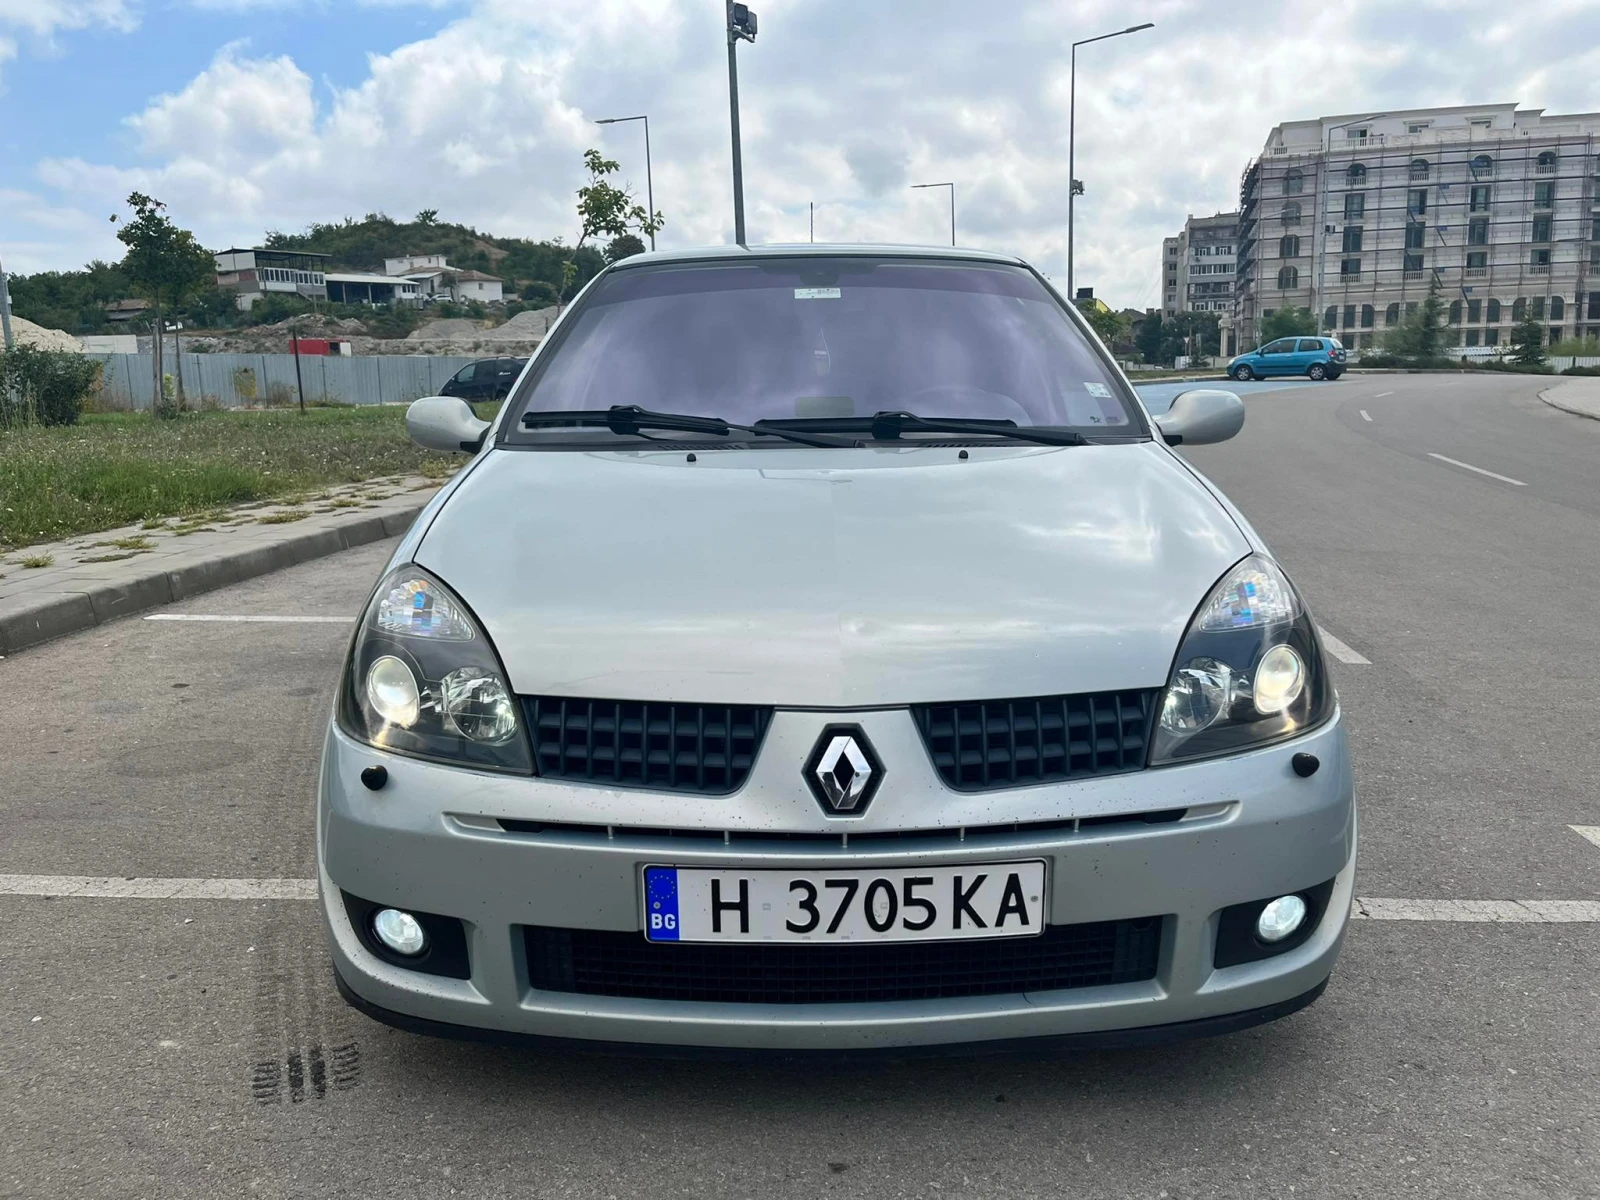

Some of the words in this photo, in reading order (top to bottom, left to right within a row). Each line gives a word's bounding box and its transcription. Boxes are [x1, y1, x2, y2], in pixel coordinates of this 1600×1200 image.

[651, 913, 676, 930] BG
[711, 878, 750, 933] H
[786, 876, 938, 933] 3705
[952, 873, 1030, 930] KA
